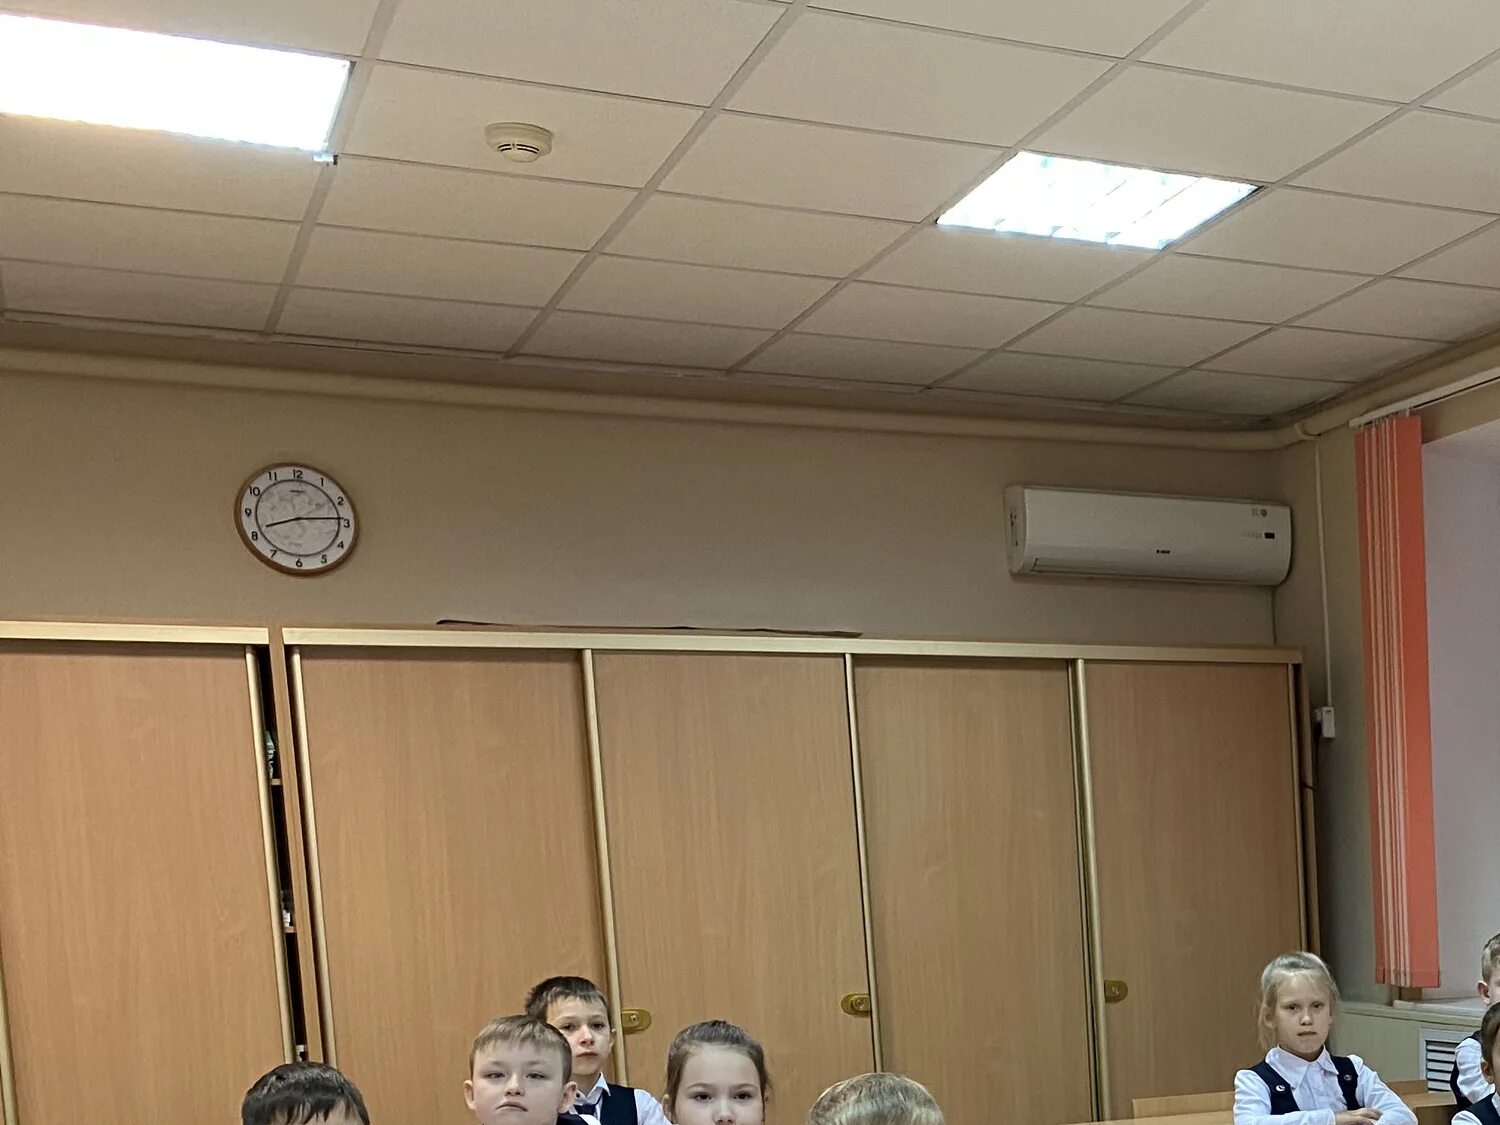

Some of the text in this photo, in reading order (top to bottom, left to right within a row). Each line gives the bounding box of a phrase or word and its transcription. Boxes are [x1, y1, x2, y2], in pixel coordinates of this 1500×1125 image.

[268, 471, 278, 481] 11
[292, 469, 304, 480] 12
[320, 477, 324, 487] 1
[248, 486, 261, 497] 10
[337, 496, 345, 506] 2
[244, 508, 252, 518] 9
[343, 518, 351, 529] 3
[251, 531, 259, 541] 8
[336, 540, 344, 550] 4
[269, 549, 277, 559] 7
[320, 554, 328, 564] 5
[295, 558, 303, 568] 6
